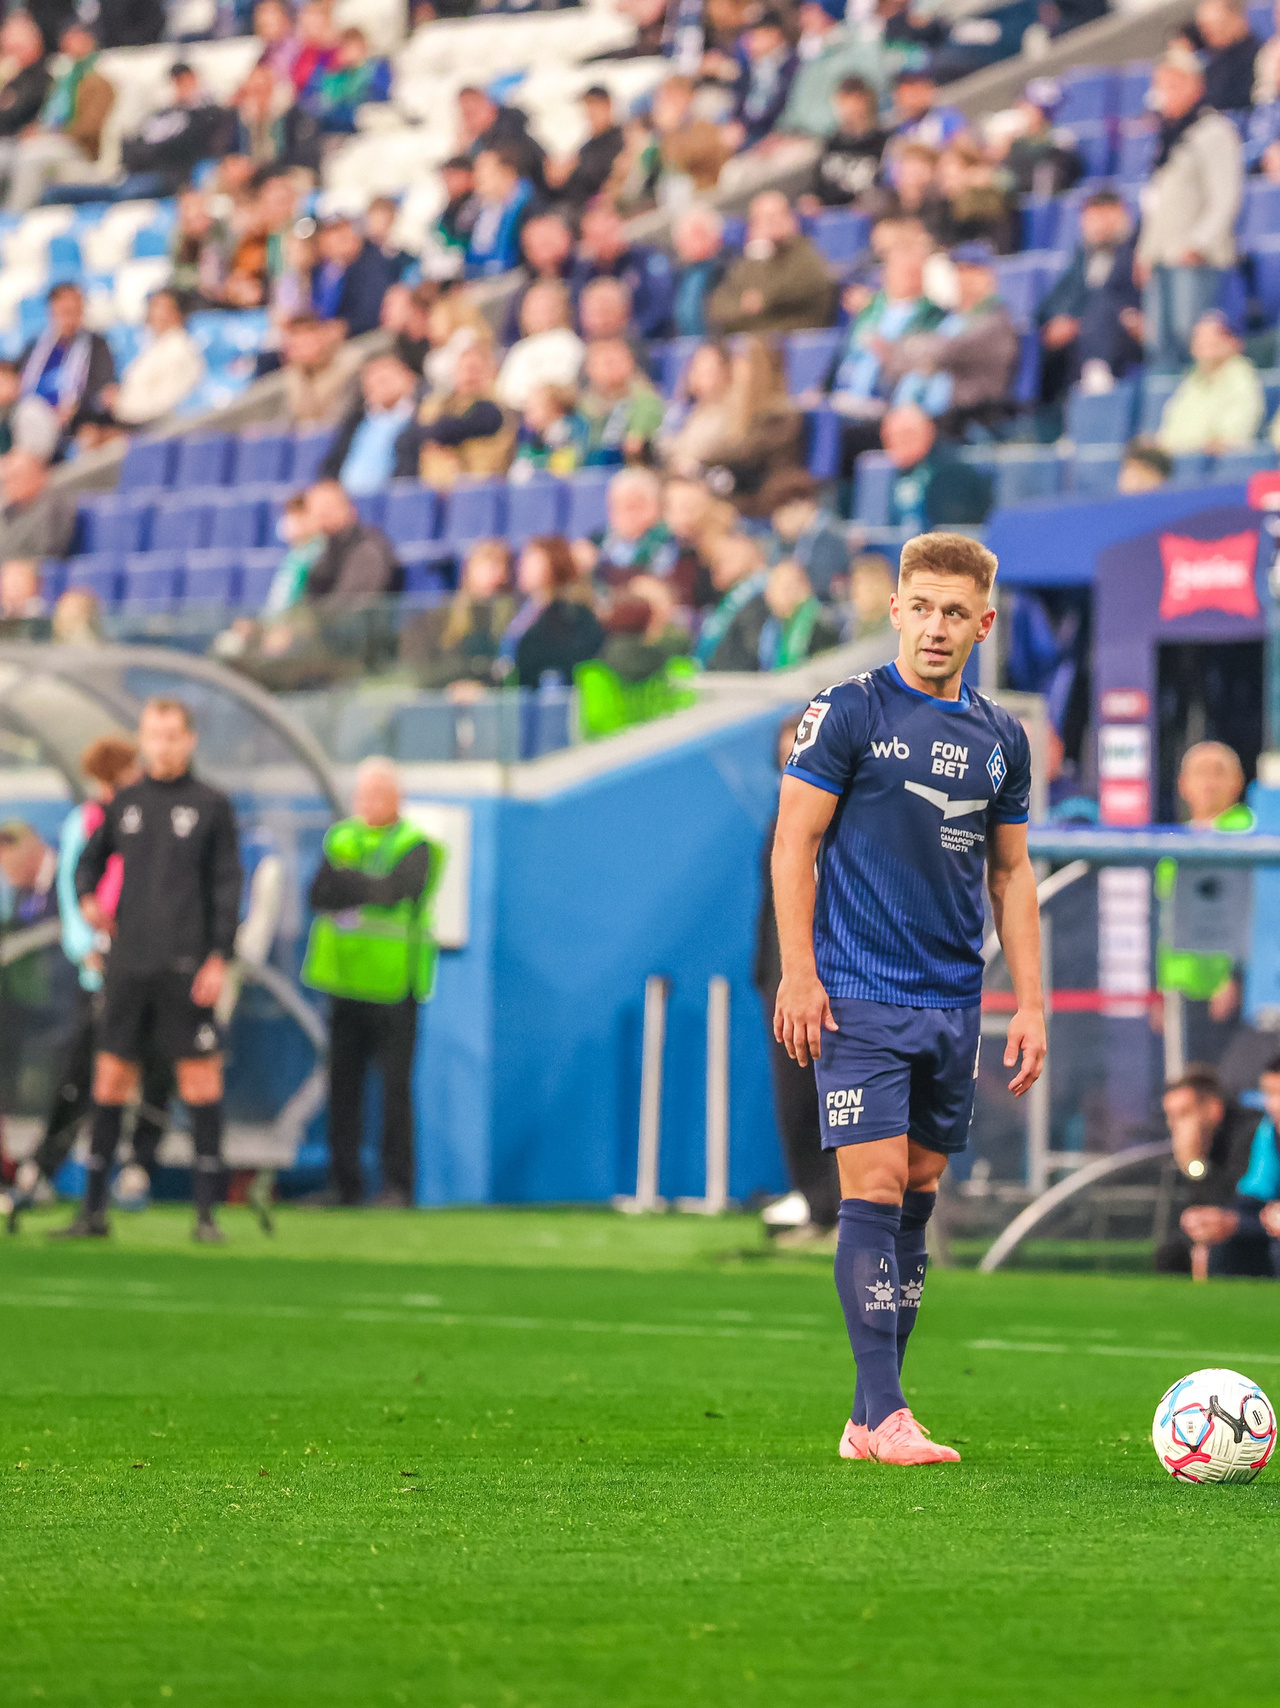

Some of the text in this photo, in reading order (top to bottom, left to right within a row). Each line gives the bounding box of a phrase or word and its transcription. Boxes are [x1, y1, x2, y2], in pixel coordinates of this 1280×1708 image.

[871, 736, 910, 760] wb
[931, 741, 968, 763] FON
[931, 758, 969, 780] BET
[826, 1088, 863, 1109] FON
[828, 1106, 865, 1127] BET
[865, 1300, 896, 1312] KELM
